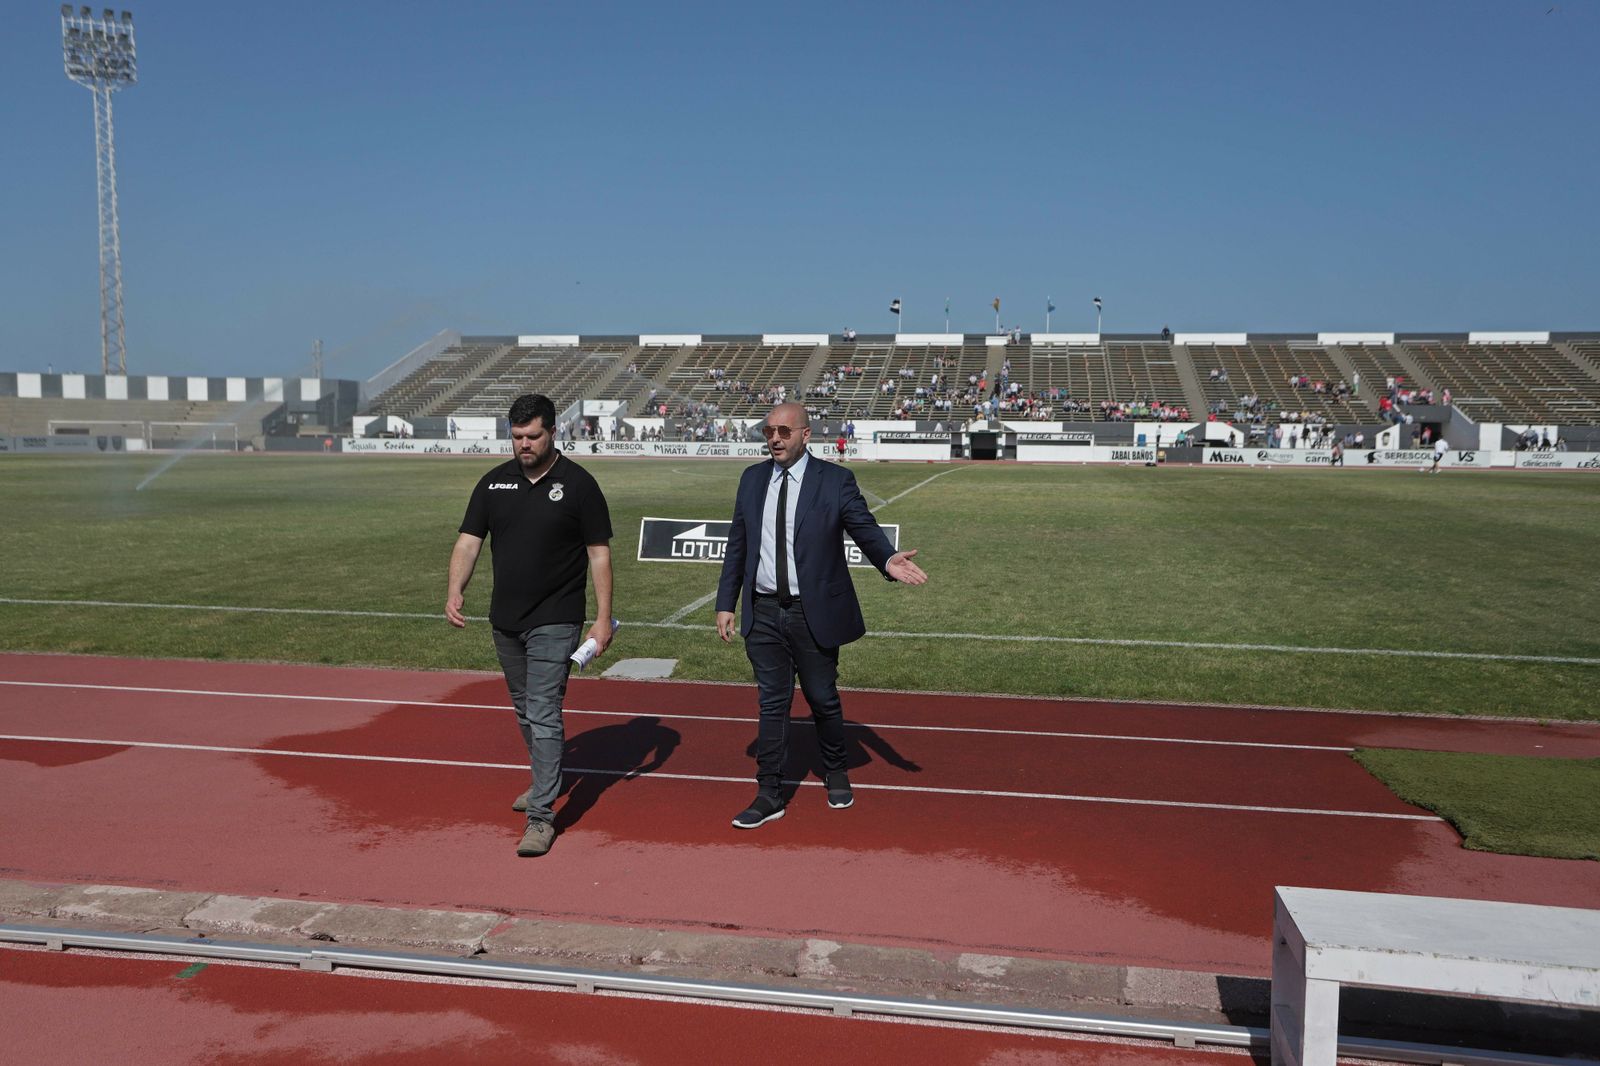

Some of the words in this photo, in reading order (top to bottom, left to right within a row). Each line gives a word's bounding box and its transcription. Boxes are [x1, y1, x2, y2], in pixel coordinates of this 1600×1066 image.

[562, 441, 576, 451] VS
[605, 443, 645, 451] SERESCOL
[1111, 450, 1131, 460] ZABAL
[1209, 450, 1245, 463] MENA
[1384, 451, 1432, 460] SERESCOL
[1458, 451, 1476, 462] VS
